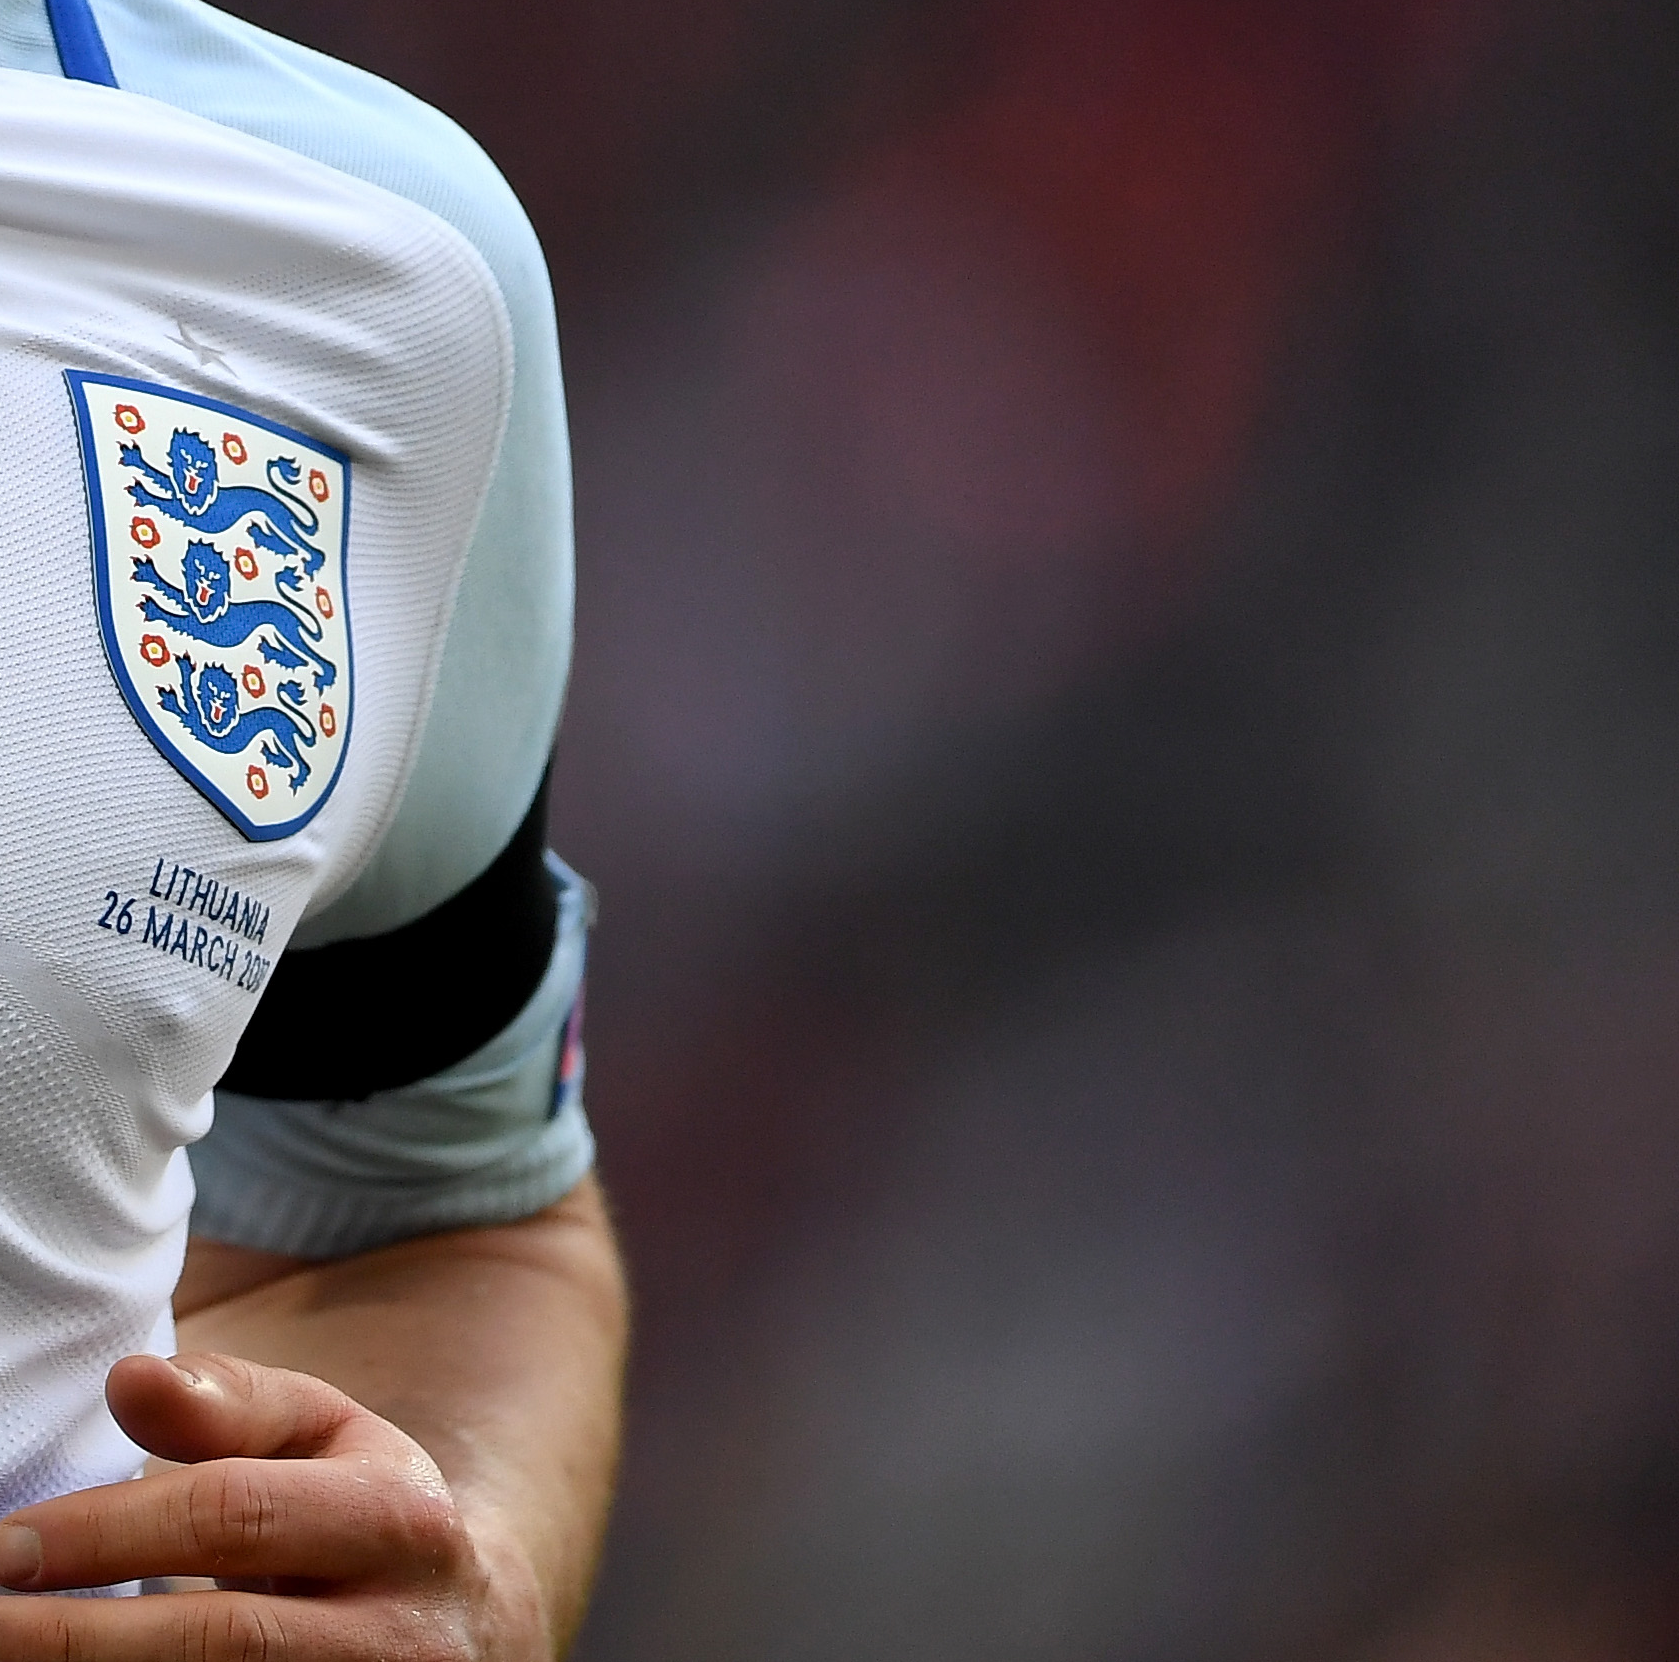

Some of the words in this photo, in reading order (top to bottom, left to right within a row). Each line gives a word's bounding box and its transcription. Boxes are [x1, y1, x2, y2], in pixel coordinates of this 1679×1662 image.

[97, 890, 137, 935] 26
[142, 905, 239, 981] MARCH
[148, 857, 271, 946] LITHUANIA
